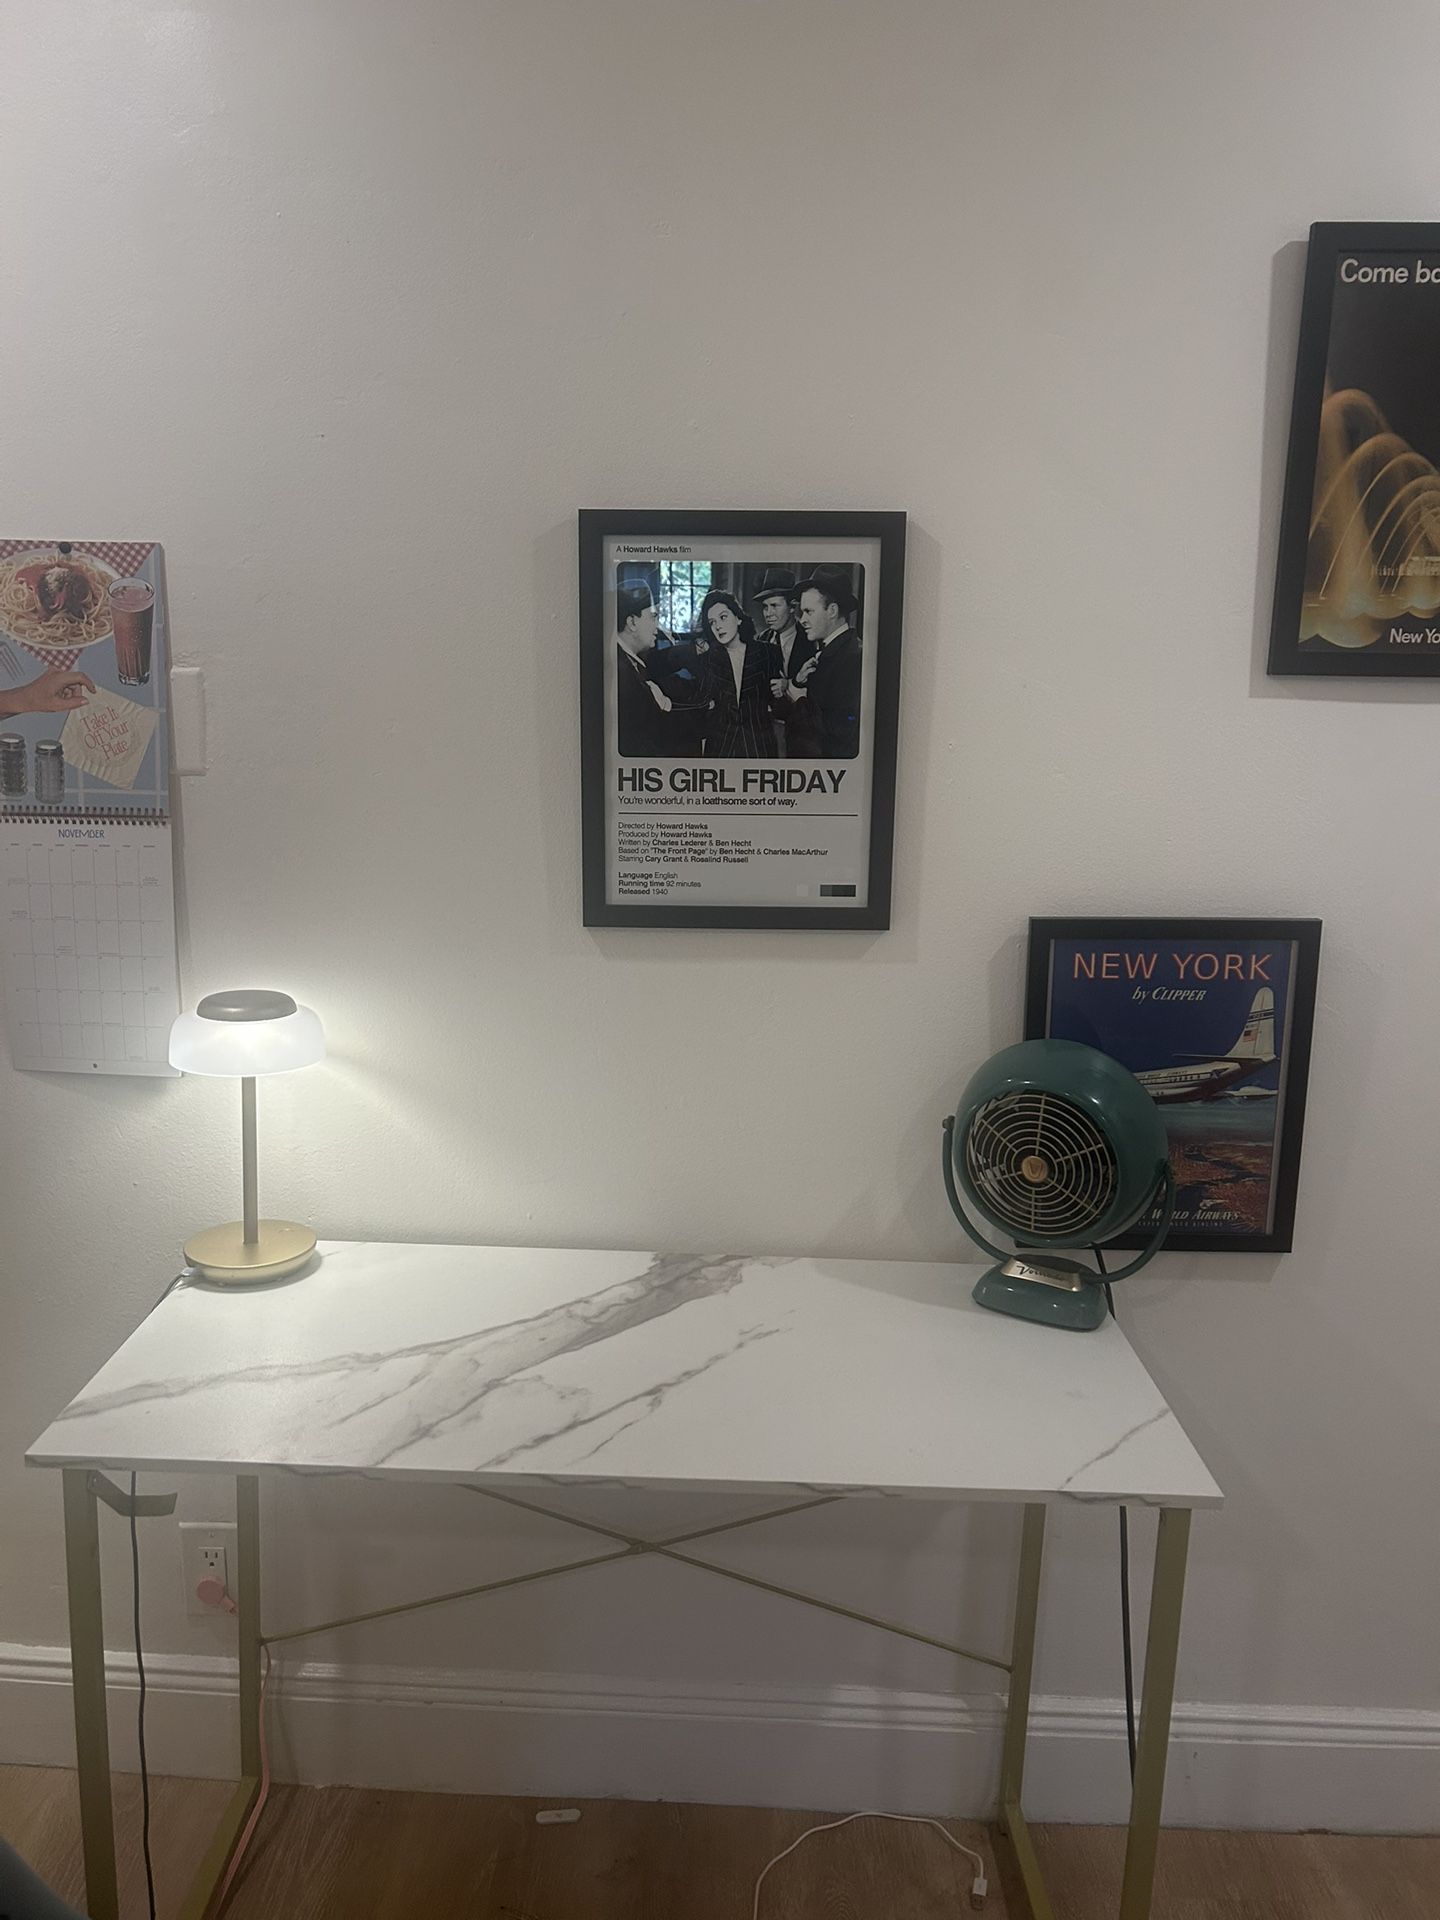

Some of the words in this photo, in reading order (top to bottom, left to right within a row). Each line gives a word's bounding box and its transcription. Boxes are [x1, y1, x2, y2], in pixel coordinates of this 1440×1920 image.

[1341, 258, 1408, 283] Come
[1390, 628, 1424, 643] New
[80, 712, 108, 731] Take
[106, 706, 119, 721] It
[84, 728, 103, 749] Off
[103, 721, 129, 739] Your
[101, 740, 128, 760] Plate
[618, 768, 663, 792] HIS
[669, 768, 735, 793] GIRL
[743, 769, 847, 793] FRIDAY
[645, 796, 685, 806] wonderful,
[687, 797, 693, 805] in
[702, 797, 747, 805] loathsome
[749, 798, 766, 806] sort
[768, 798, 776, 806] of
[777, 799, 797, 807] way.
[58, 829, 105, 839] NOVEMBER
[651, 831, 659, 839] by
[642, 839, 651, 847] by
[709, 848, 718, 856] by
[618, 856, 643, 864] Starring
[645, 856, 662, 864] Cary
[618, 872, 653, 880] Language
[654, 872, 678, 880] English
[618, 880, 648, 888] Running
[1073, 953, 1158, 980] NEW
[1173, 953, 1273, 980] YORK
[1132, 987, 1150, 1005] by
[1152, 987, 1207, 1001] CLIPPER
